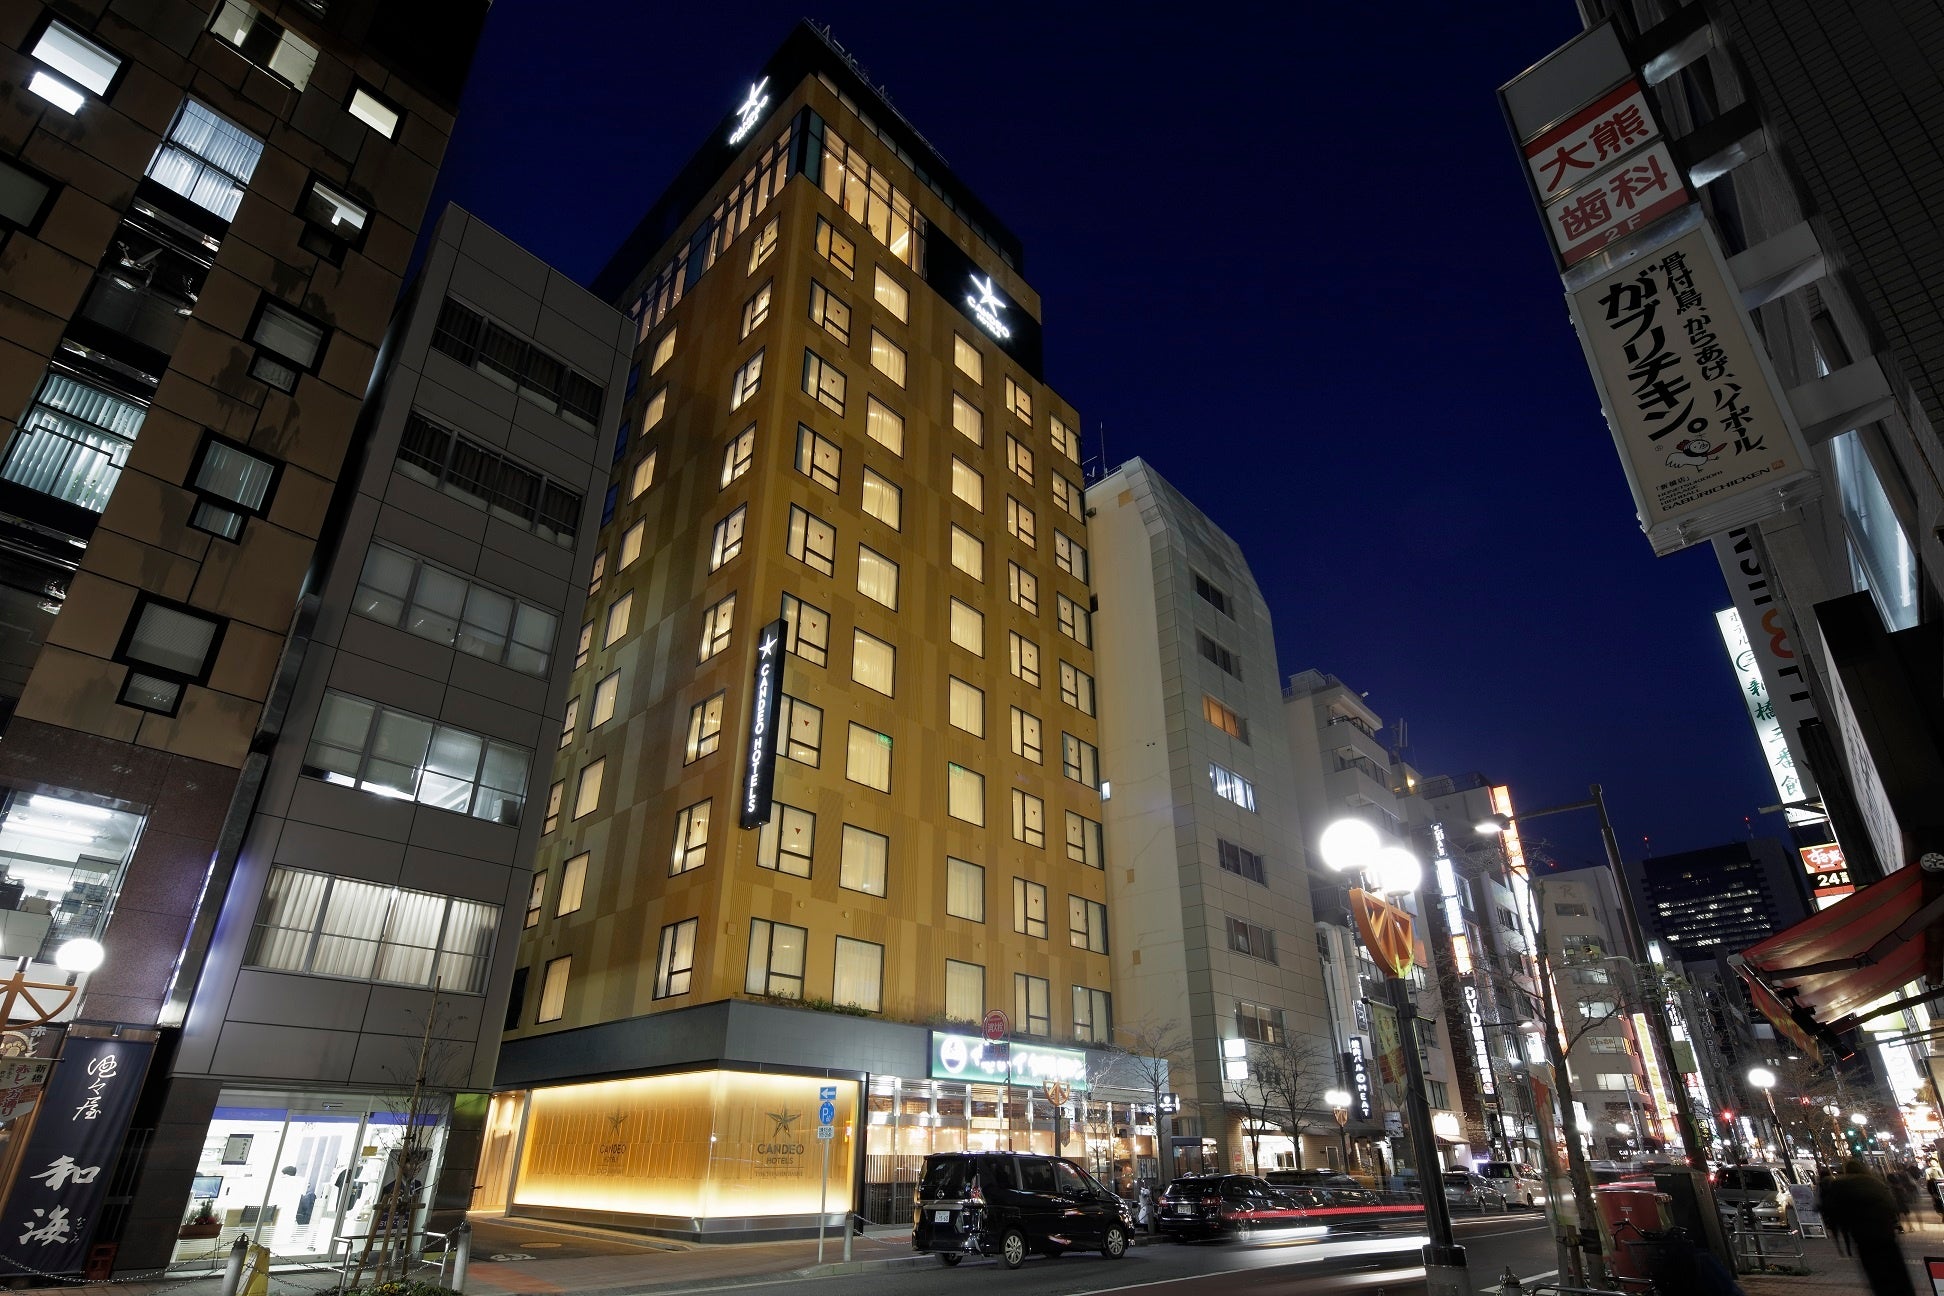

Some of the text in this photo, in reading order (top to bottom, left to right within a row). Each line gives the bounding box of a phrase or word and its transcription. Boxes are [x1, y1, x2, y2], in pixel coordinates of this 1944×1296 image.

[1539, 103, 1649, 193] 大熊
[1558, 155, 1668, 241] 歯科
[1662, 467, 1771, 512] GABURICHICKEN
[747, 663, 770, 813] CANDEO HOTELS
[1357, 1084, 1369, 1117] MEAT
[599, 1143, 627, 1155] CANDEO
[757, 1143, 805, 1156] CANDEO
[766, 1156, 794, 1165] HOTELS
[18, 1154, 101, 1247] 和海
